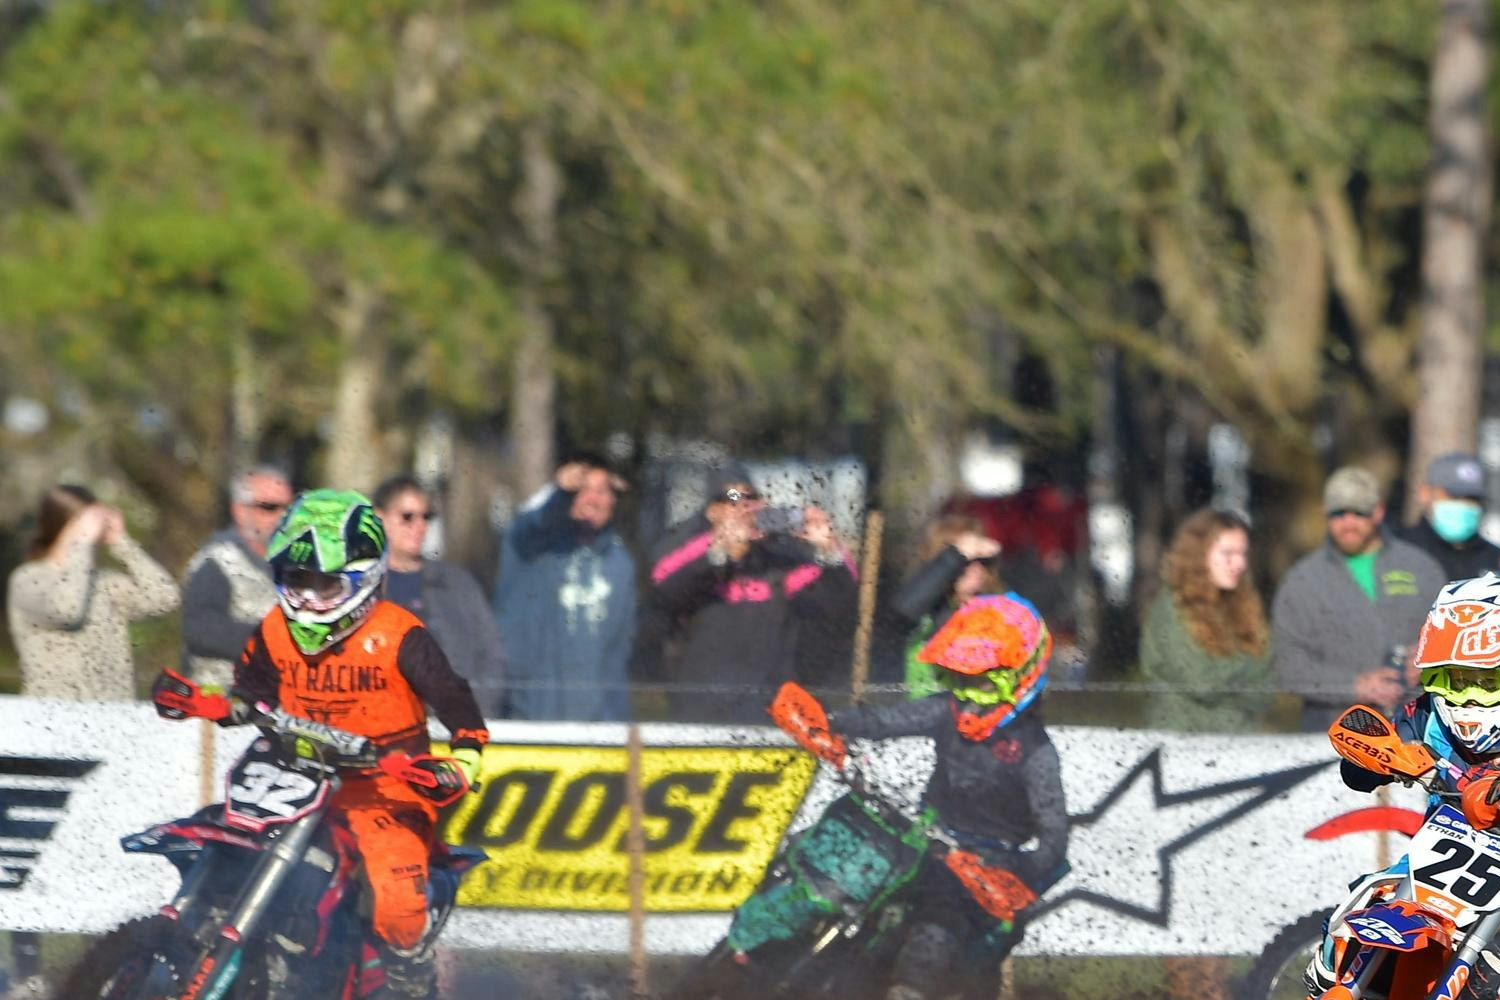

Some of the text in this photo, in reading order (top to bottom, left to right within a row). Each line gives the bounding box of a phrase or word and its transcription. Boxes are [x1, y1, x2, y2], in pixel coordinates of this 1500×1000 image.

[306, 663, 387, 693] RACING
[1333, 732, 1392, 764] ACERBIS
[437, 768, 783, 852] OOSE
[1426, 824, 1465, 841] ETHAN
[518, 868, 741, 894] DIVIION
